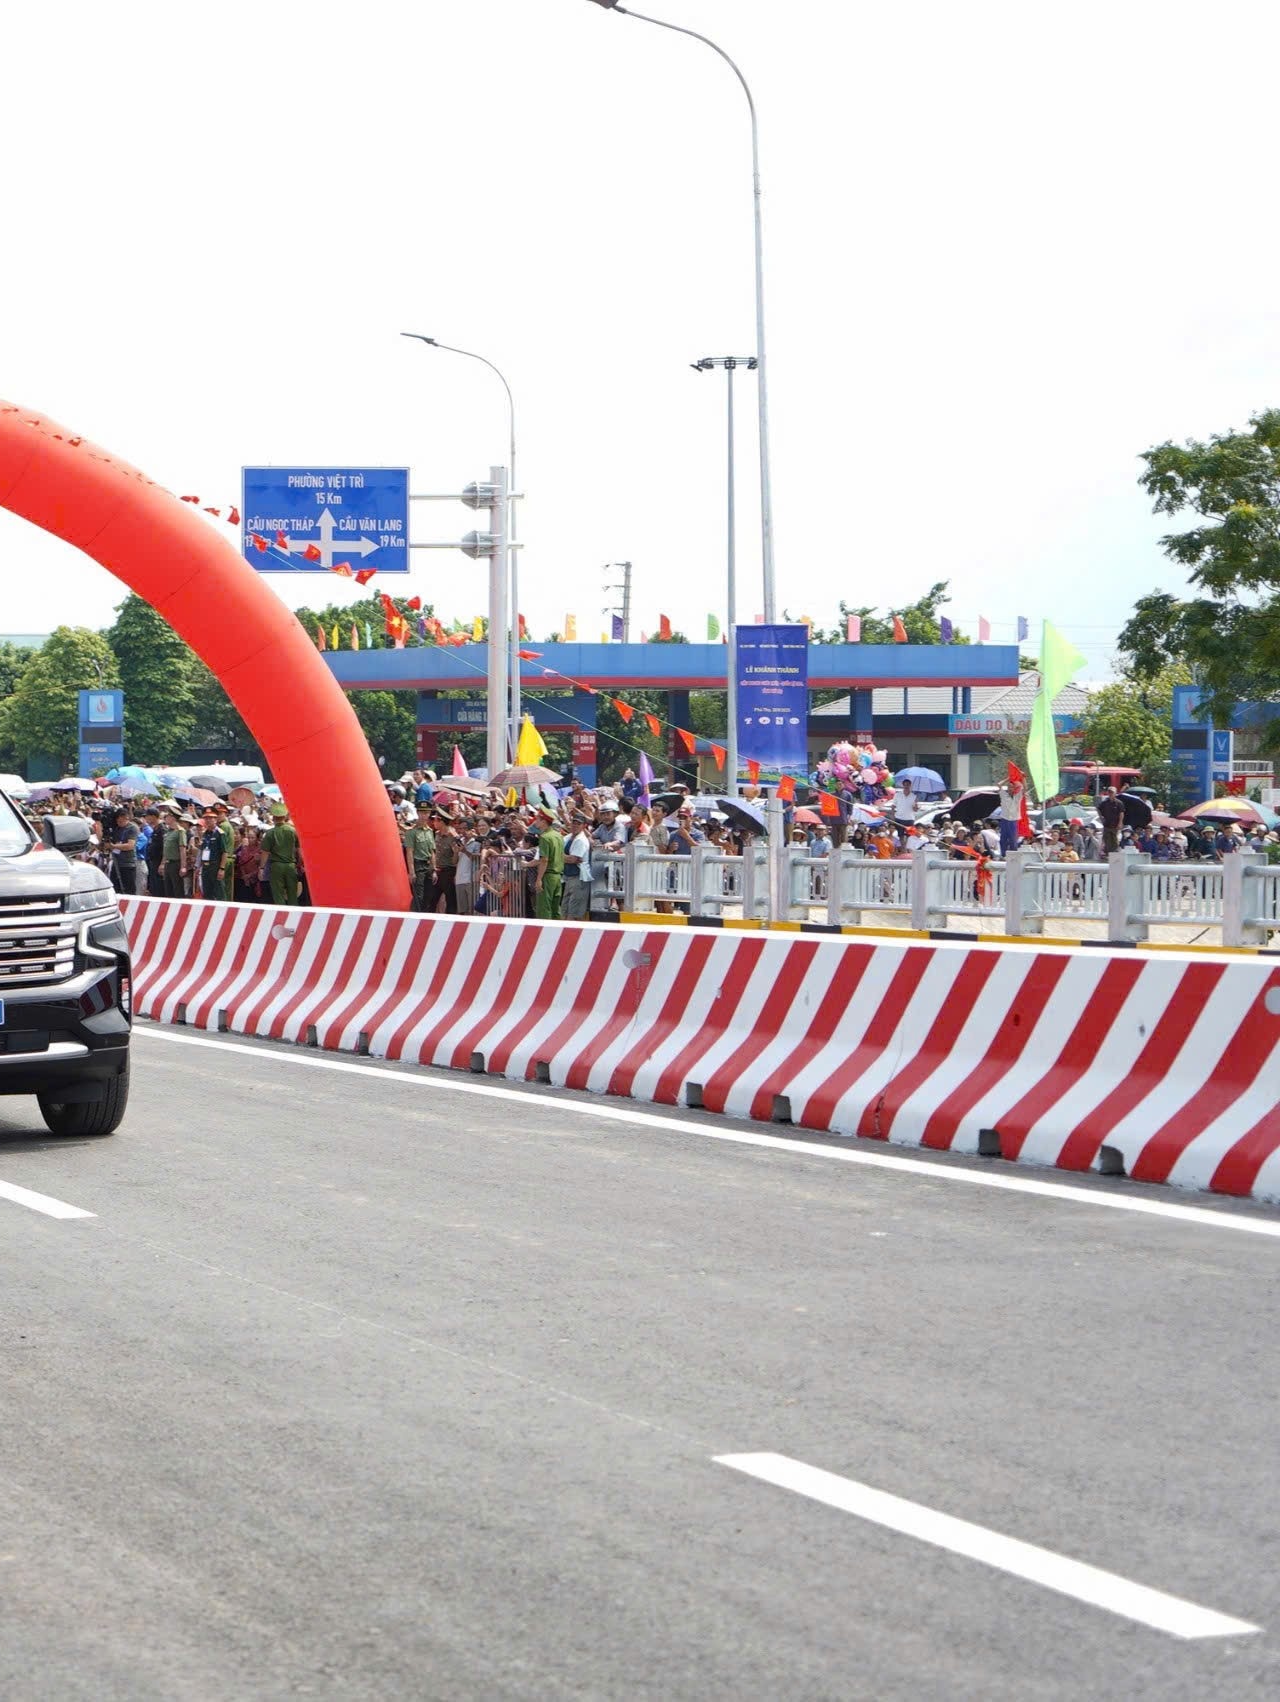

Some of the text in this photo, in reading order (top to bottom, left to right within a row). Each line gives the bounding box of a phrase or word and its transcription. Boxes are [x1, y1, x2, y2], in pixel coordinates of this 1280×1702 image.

[288, 472, 364, 489] PHƯỜNG VIỆT TRÌ
[315, 493, 342, 504] 15 Km
[291, 517, 314, 531] THÁP
[358, 517, 377, 531] VĂN
[378, 519, 402, 531] LANG
[380, 535, 405, 547] 19 Km
